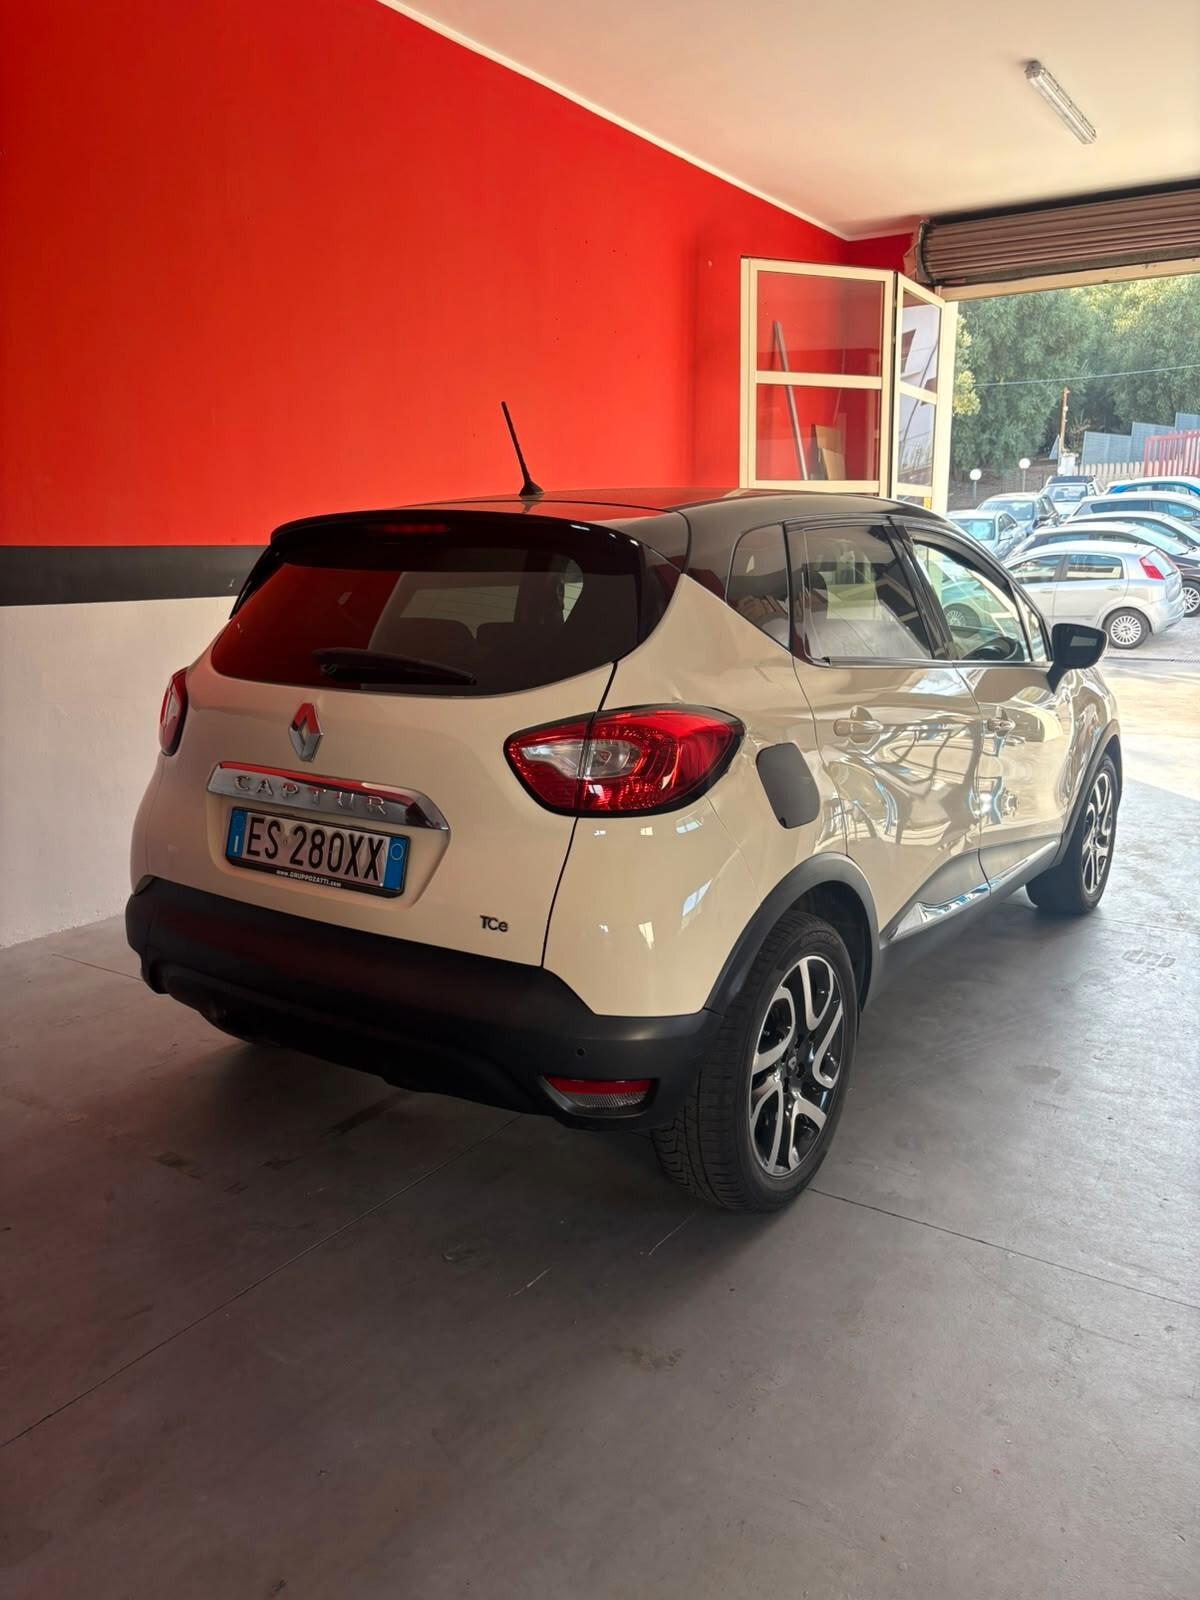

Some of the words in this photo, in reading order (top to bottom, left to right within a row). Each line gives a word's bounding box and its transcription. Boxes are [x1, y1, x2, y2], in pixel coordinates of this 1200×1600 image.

[234, 775, 386, 815] CAPTUR
[246, 816, 282, 860] ES
[289, 823, 385, 881] 280XX
[479, 914, 508, 933] TCe
